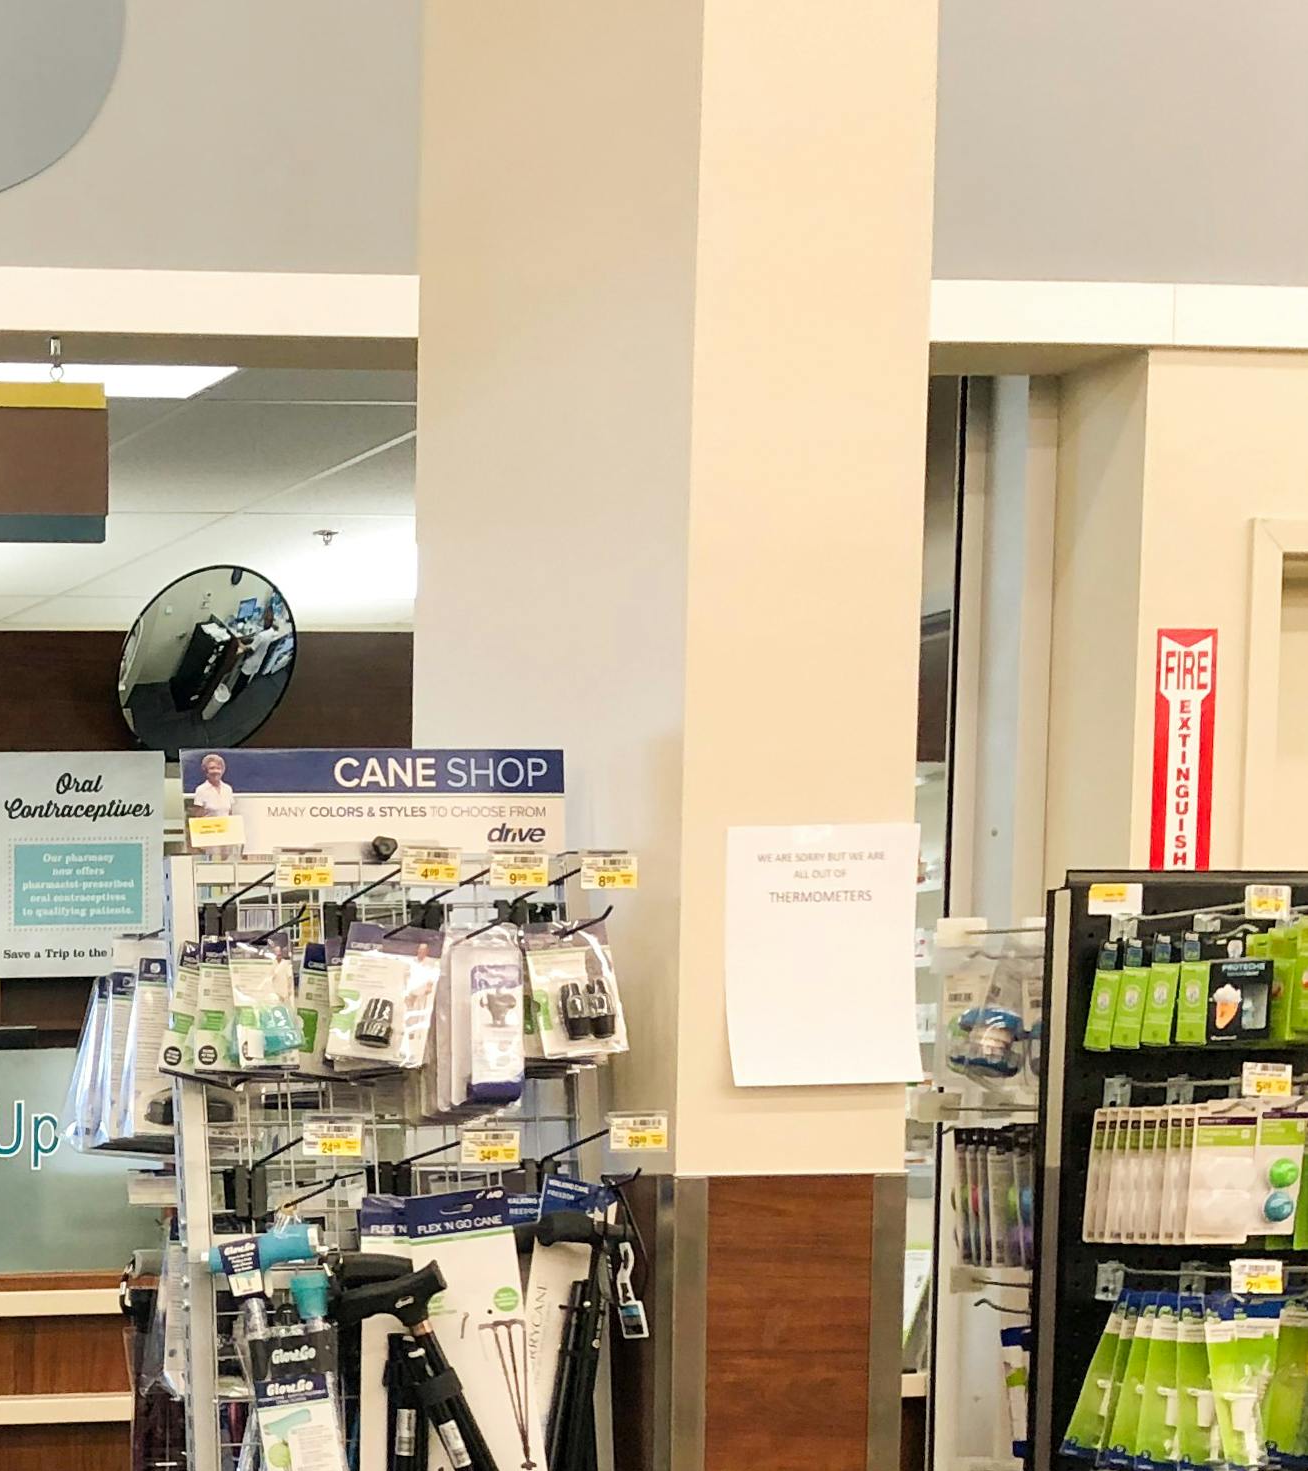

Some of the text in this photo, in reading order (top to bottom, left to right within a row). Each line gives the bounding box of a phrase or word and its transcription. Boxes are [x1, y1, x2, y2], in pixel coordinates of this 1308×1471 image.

[1164, 650, 1209, 690] FIRE
[333, 756, 549, 789] CANE SHOP
[56, 772, 104, 794] Oral
[4, 797, 154, 822] Contraceptives
[267, 806, 547, 818] MANY COLORS & STYLES TO CHOOSE FROM
[487, 823, 546, 843] drive
[65, 853, 115, 864] pharmacy
[757, 850, 885, 863] WE ARE SORRY BUT WE ARE
[793, 868, 847, 879] ALL OUT OF
[769, 890, 873, 903] THERMOMETERS
[3, 949, 31, 959] Save
[33, 951, 41, 959] a
[45, 948, 70, 960] Trip
[73, 949, 85, 958] to
[88, 948, 108, 958] the
[417, 1223, 442, 1234] FLEX
[455, 1219, 473, 1230] GO
[473, 1214, 502, 1226] CANE
